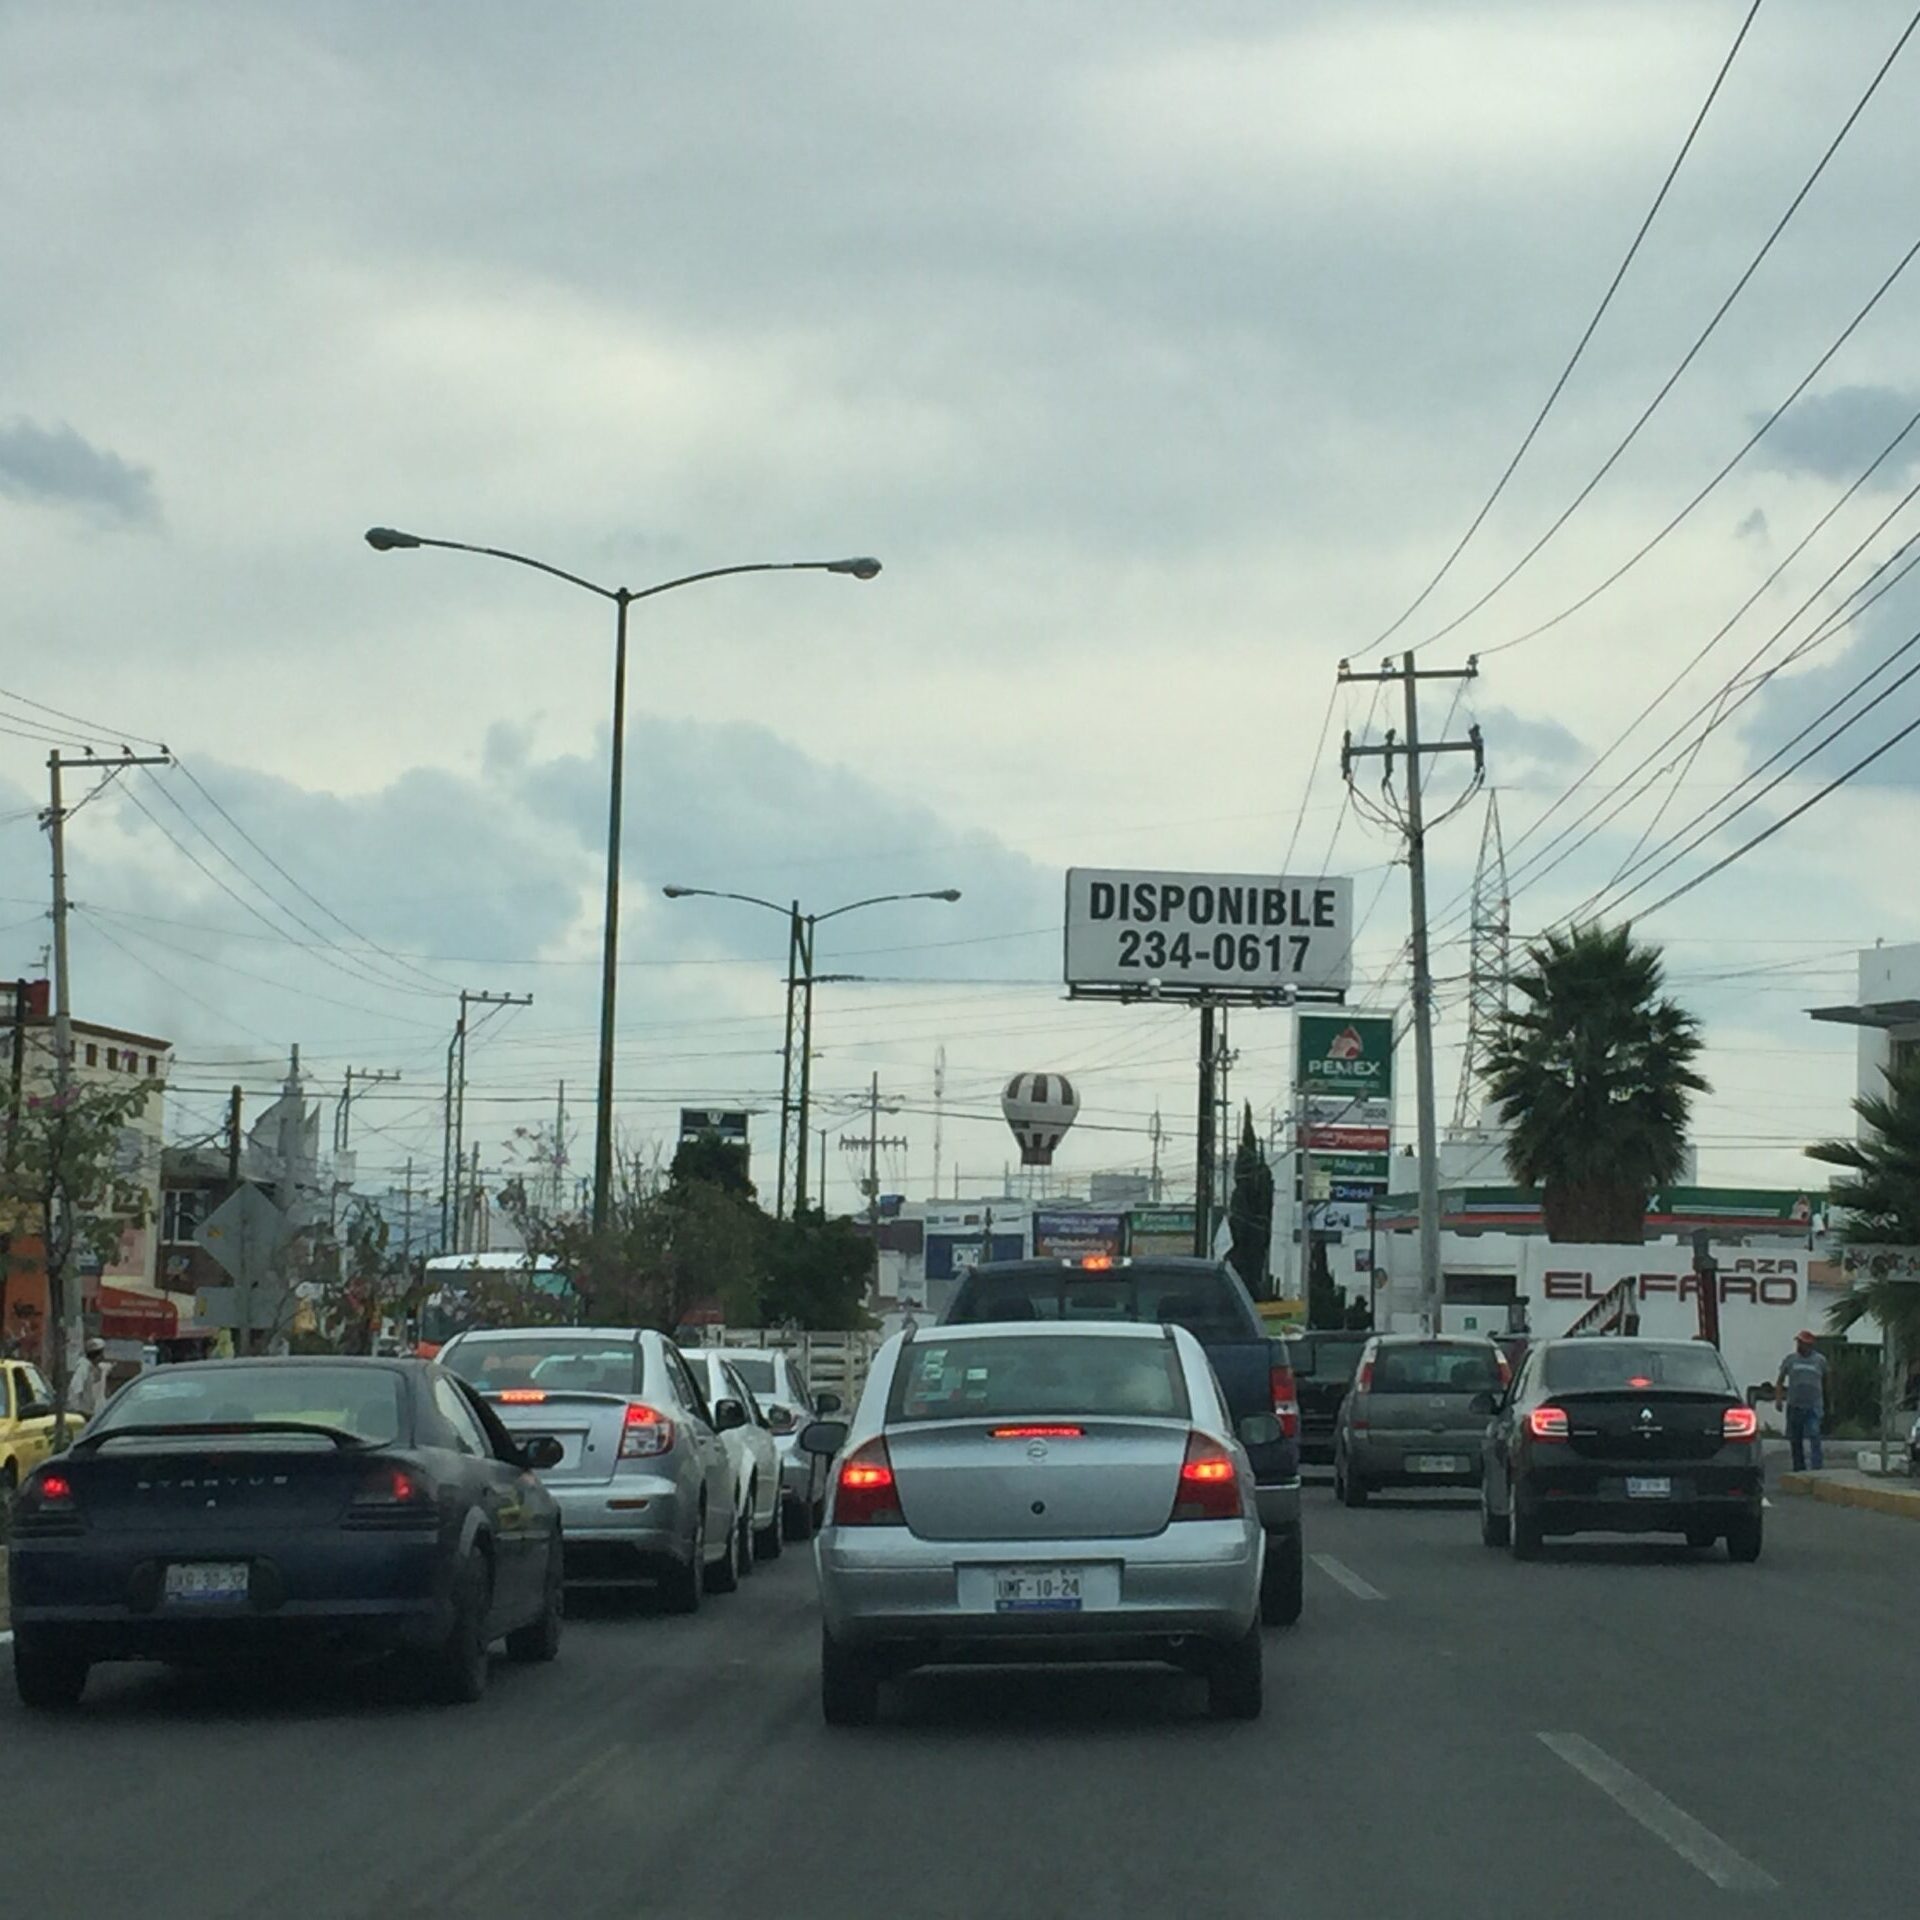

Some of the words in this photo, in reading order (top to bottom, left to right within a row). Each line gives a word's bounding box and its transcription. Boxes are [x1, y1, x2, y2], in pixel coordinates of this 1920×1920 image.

[1090, 881, 1335, 928] DISPONIBLE
[1118, 930, 1311, 972] 234-0617
[1308, 1060, 1380, 1075] PEMEX
[1715, 1258, 1797, 1274] LAZA
[1639, 1274, 1797, 1305] FARO
